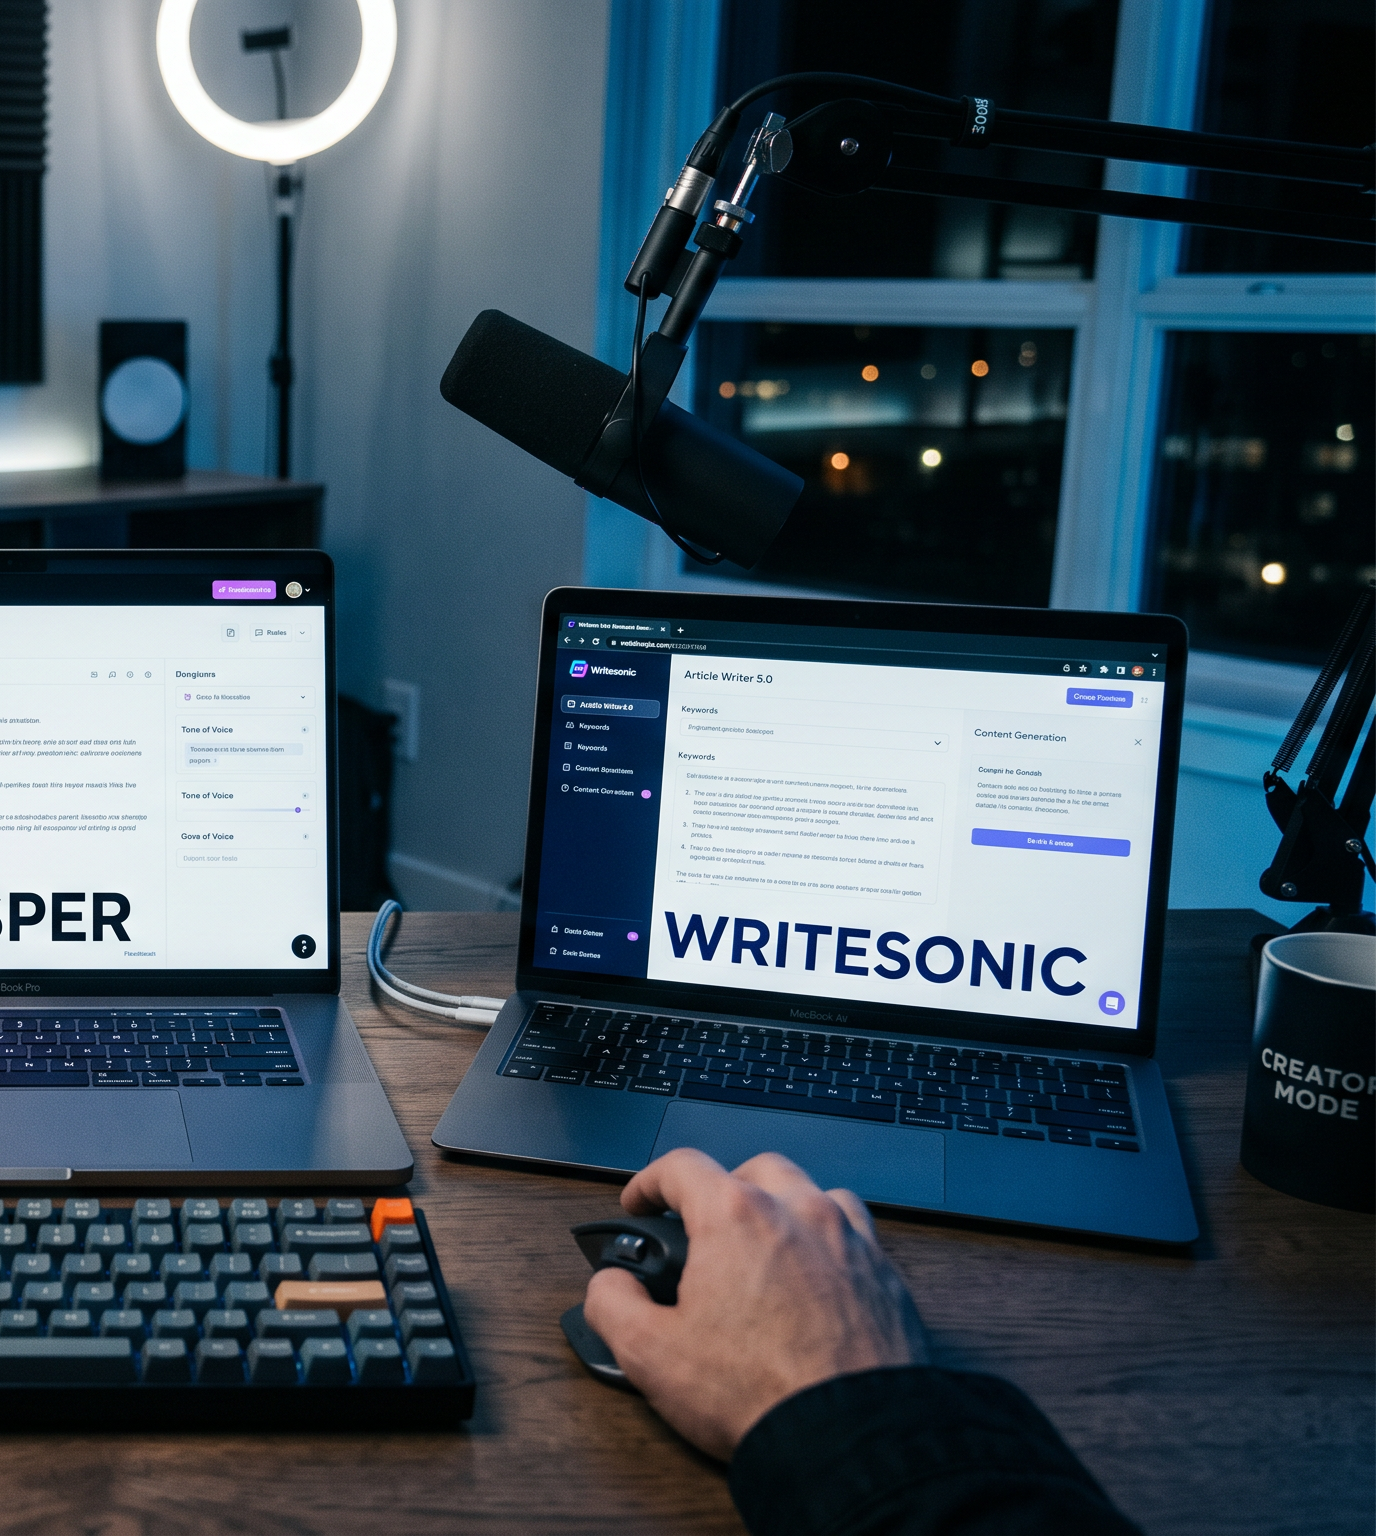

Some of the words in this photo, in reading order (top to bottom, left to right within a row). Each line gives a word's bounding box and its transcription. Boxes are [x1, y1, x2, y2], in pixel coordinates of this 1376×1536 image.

[590, 665, 637, 677] Writesonic
[684, 669, 719, 681] Article
[721, 672, 754, 684] Writer
[756, 674, 773, 684] 5.0
[681, 705, 718, 715] Keywords
[974, 728, 1013, 739] Content
[1014, 730, 1067, 743] Generation
[678, 751, 715, 762] Keywords
[212, 792, 234, 800] Voice
[202, 832, 211, 840] of
[212, 832, 234, 840] Voice
[664, 910, 1088, 997] WRITESONIC
[25, 983, 41, 992] Pro
[1274, 1080, 1359, 1120] MODE
